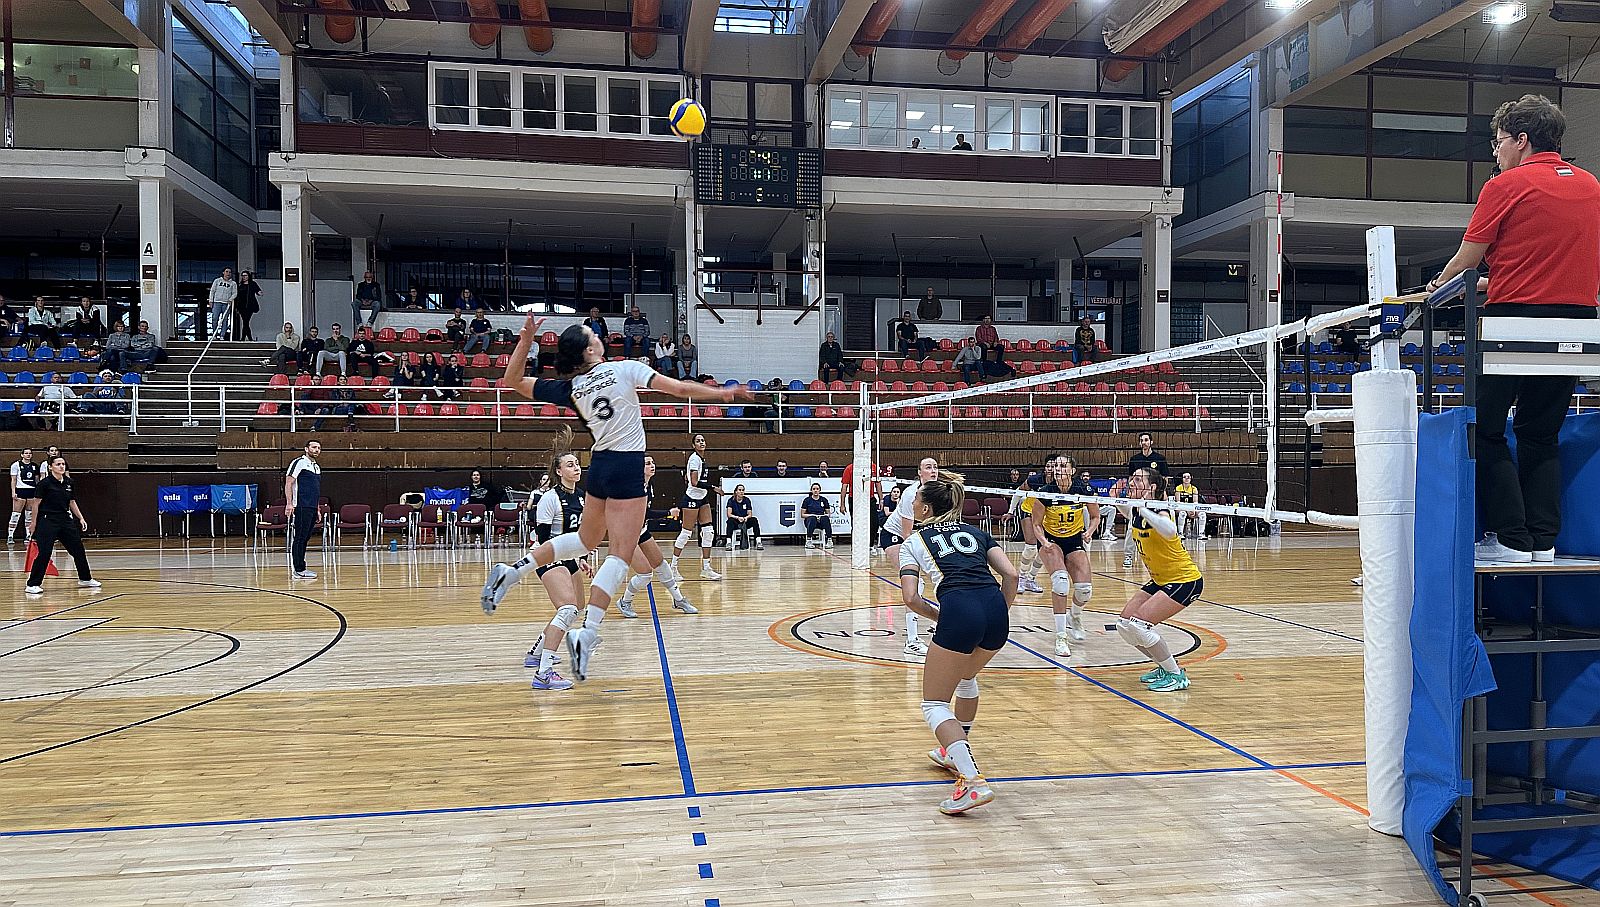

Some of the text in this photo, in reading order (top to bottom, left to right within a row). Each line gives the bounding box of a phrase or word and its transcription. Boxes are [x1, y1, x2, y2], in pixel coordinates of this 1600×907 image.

[143, 242, 154, 255] A
[592, 396, 614, 420] 3
[1059, 511, 1075, 523] 15
[891, 535, 899, 543] 6
[930, 531, 979, 558] 10
